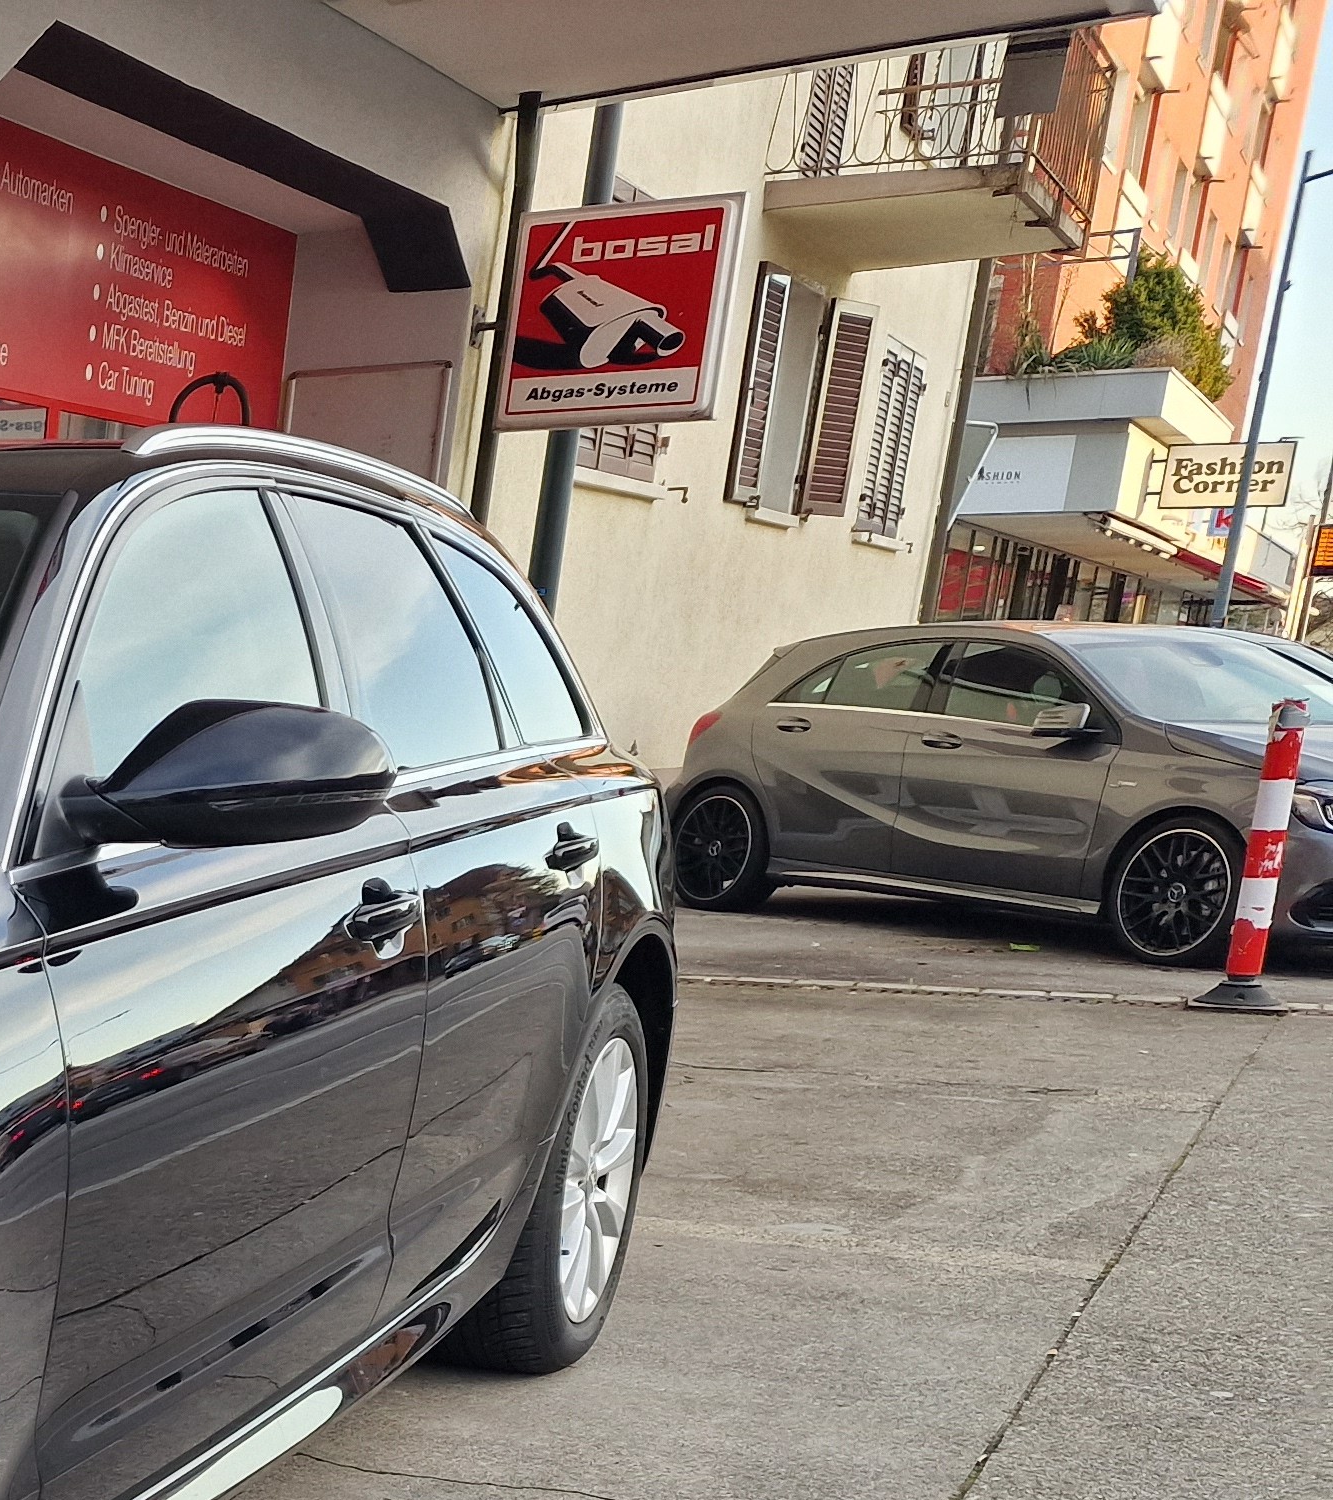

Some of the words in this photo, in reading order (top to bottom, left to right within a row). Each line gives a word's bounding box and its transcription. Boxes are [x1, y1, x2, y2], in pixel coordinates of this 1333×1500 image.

[0, 161, 74, 215] Automarken
[110, 242, 173, 289] Klimaservice
[114, 205, 163, 250] Spengler-
[165, 230, 186, 256] und
[185, 232, 249, 278] Malerarbeiten
[572, 224, 716, 263] bosal
[106, 283, 160, 328] Abgastest,
[163, 300, 197, 335] Benzin
[198, 314, 218, 340] und
[217, 316, 248, 348] Diesel
[102, 322, 128, 354] MFK
[129, 329, 196, 377] Bereitstellung
[98, 361, 120, 391] Car
[121, 366, 155, 406] Tuning
[525, 380, 679, 402] Abgas-Systeme
